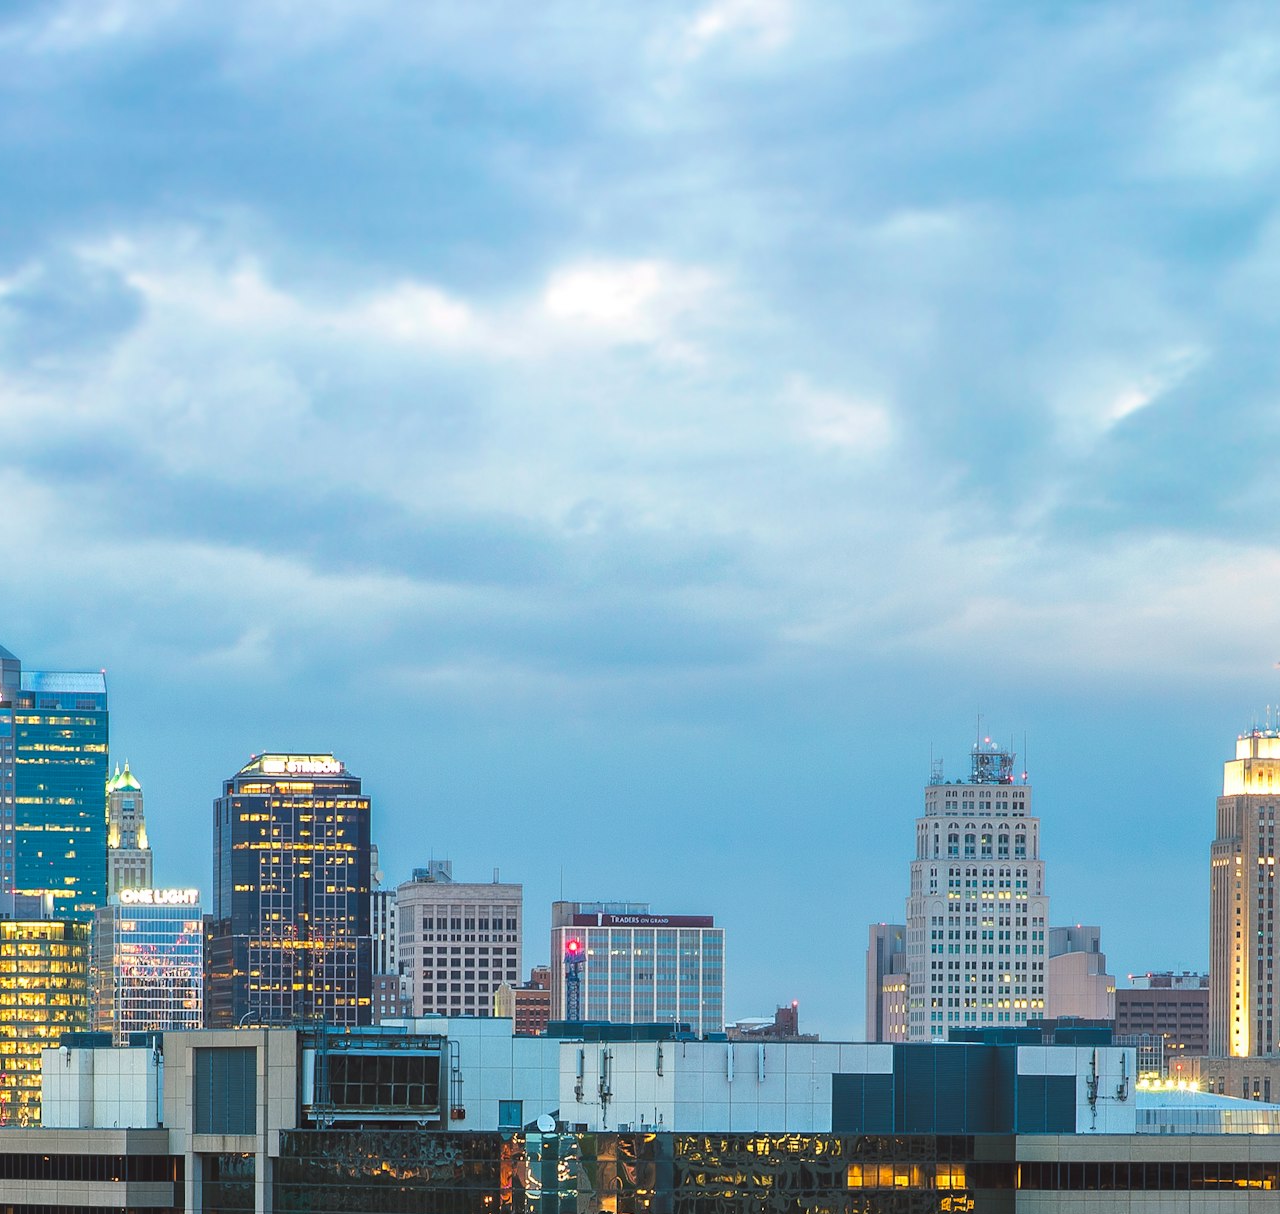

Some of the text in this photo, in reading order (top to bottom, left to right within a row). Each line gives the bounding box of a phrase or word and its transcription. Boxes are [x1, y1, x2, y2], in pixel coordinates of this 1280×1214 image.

[120, 888, 199, 904] ONE LIGHT
[610, 915, 640, 924] TRADERS
